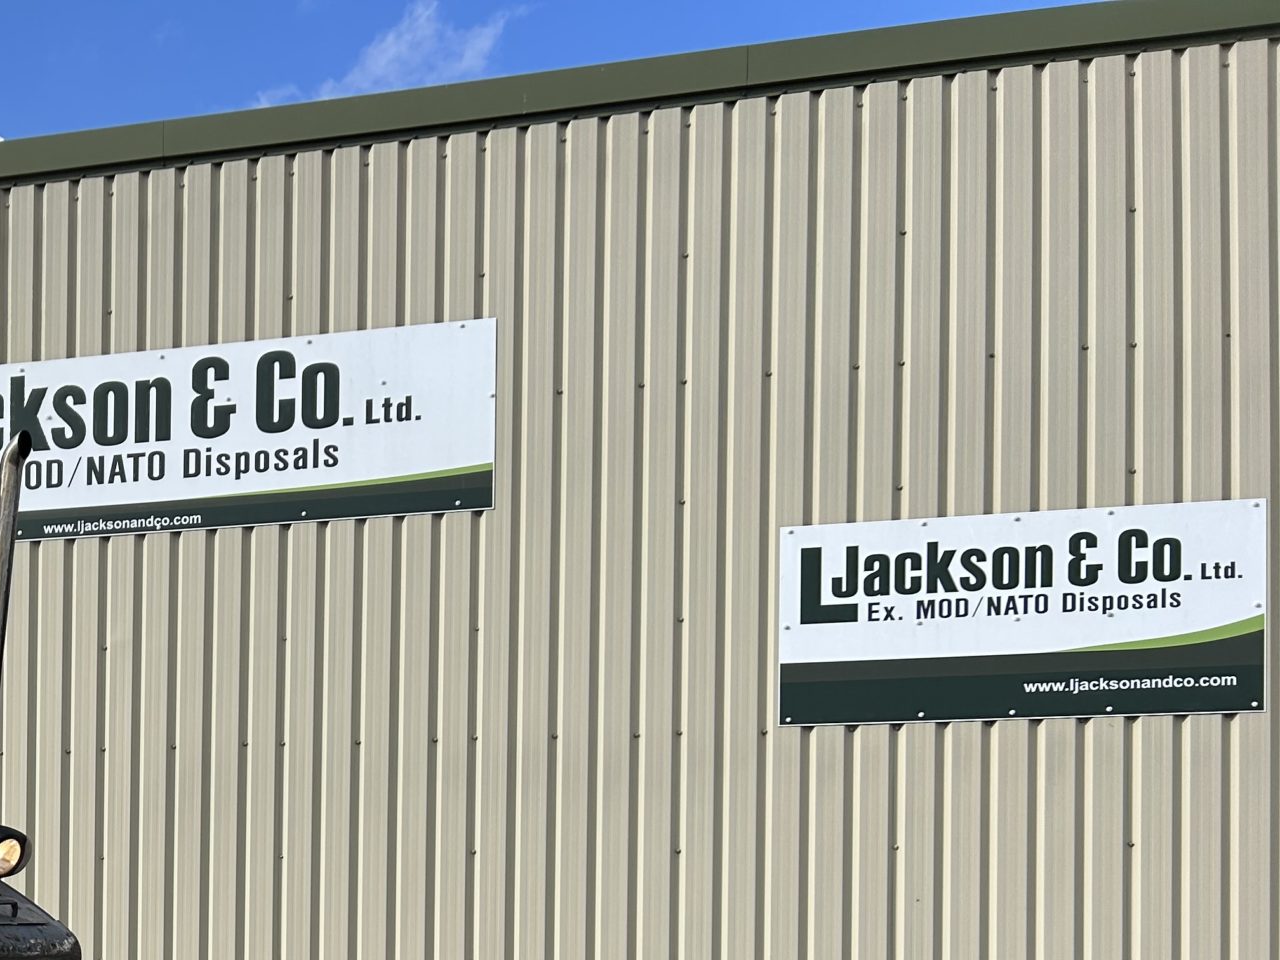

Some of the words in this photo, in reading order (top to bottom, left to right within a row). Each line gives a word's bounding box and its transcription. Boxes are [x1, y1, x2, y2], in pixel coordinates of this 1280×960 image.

[190, 356, 237, 439] &
[255, 350, 355, 434] Co.
[365, 395, 422, 425] Ltd.
[183, 438, 340, 481] Disposals
[43, 514, 202, 535] www.ljacksonandco.com
[1067, 531, 1103, 587] &
[1117, 528, 1193, 584] Co.
[1200, 561, 1244, 581] Ltd.
[867, 602, 904, 622] Ex.
[916, 593, 1049, 620] MOD/NATO
[1062, 587, 1182, 614] Disposals
[1023, 674, 1238, 694] www.ljacksonandco.com
